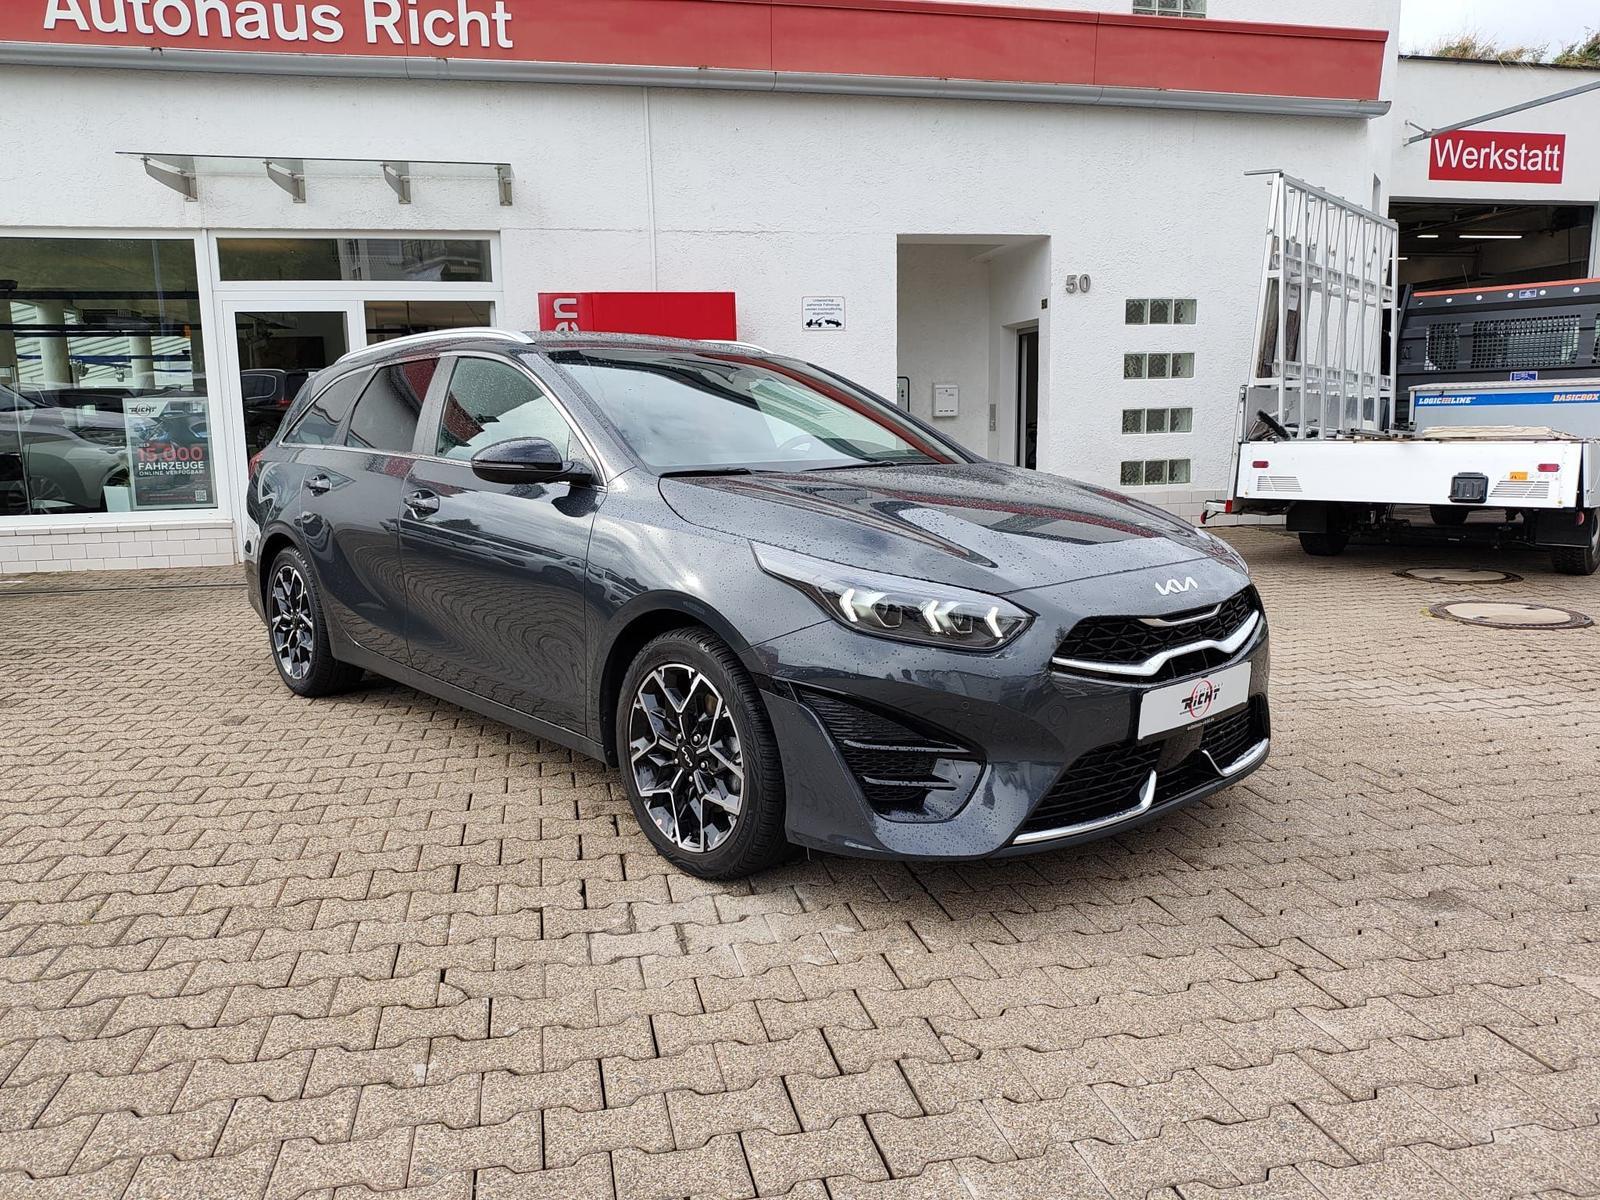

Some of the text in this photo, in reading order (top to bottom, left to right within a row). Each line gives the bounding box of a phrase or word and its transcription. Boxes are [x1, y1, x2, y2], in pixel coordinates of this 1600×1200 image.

[43, 0, 514, 49] Autohaus Richt
[1433, 138, 1561, 171] Werkstatt
[1065, 273, 1091, 294] 50
[1552, 393, 1599, 402] BASICBOX
[138, 461, 205, 471] FAHRZEUGE
